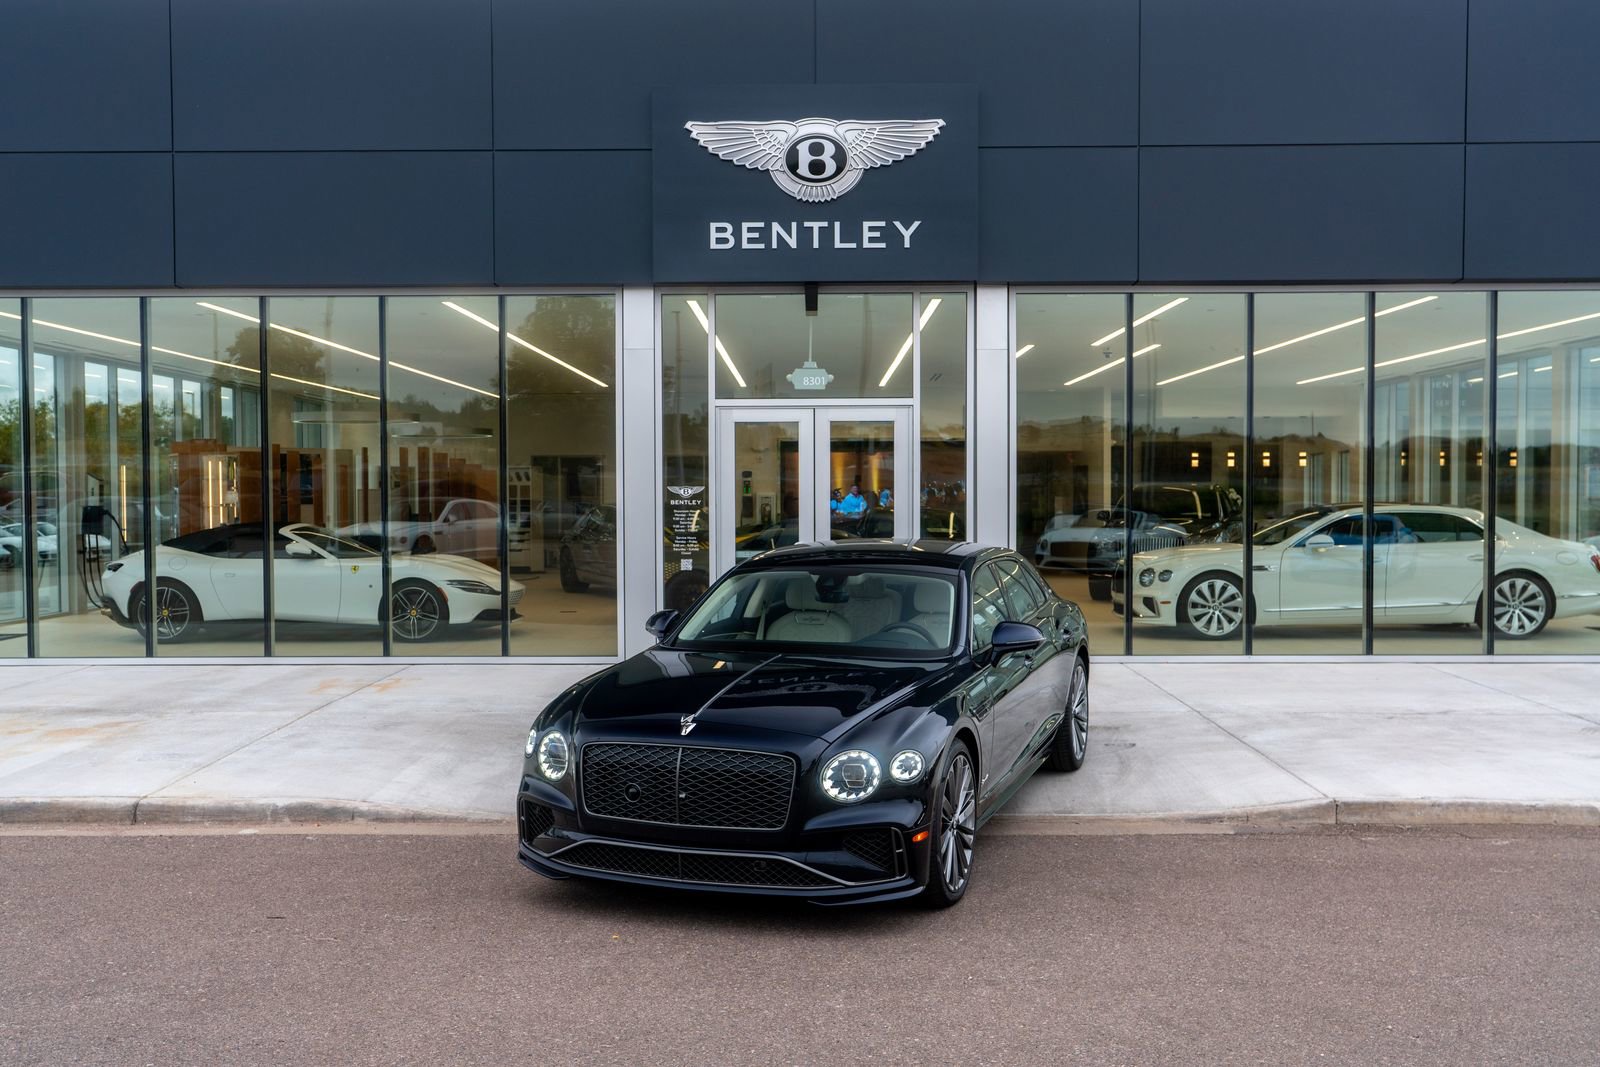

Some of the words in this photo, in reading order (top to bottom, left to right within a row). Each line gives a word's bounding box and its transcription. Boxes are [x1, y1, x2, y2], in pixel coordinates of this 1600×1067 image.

[795, 138, 837, 179] B
[709, 221, 922, 249] BENTLEY
[803, 376, 825, 386] 8301
